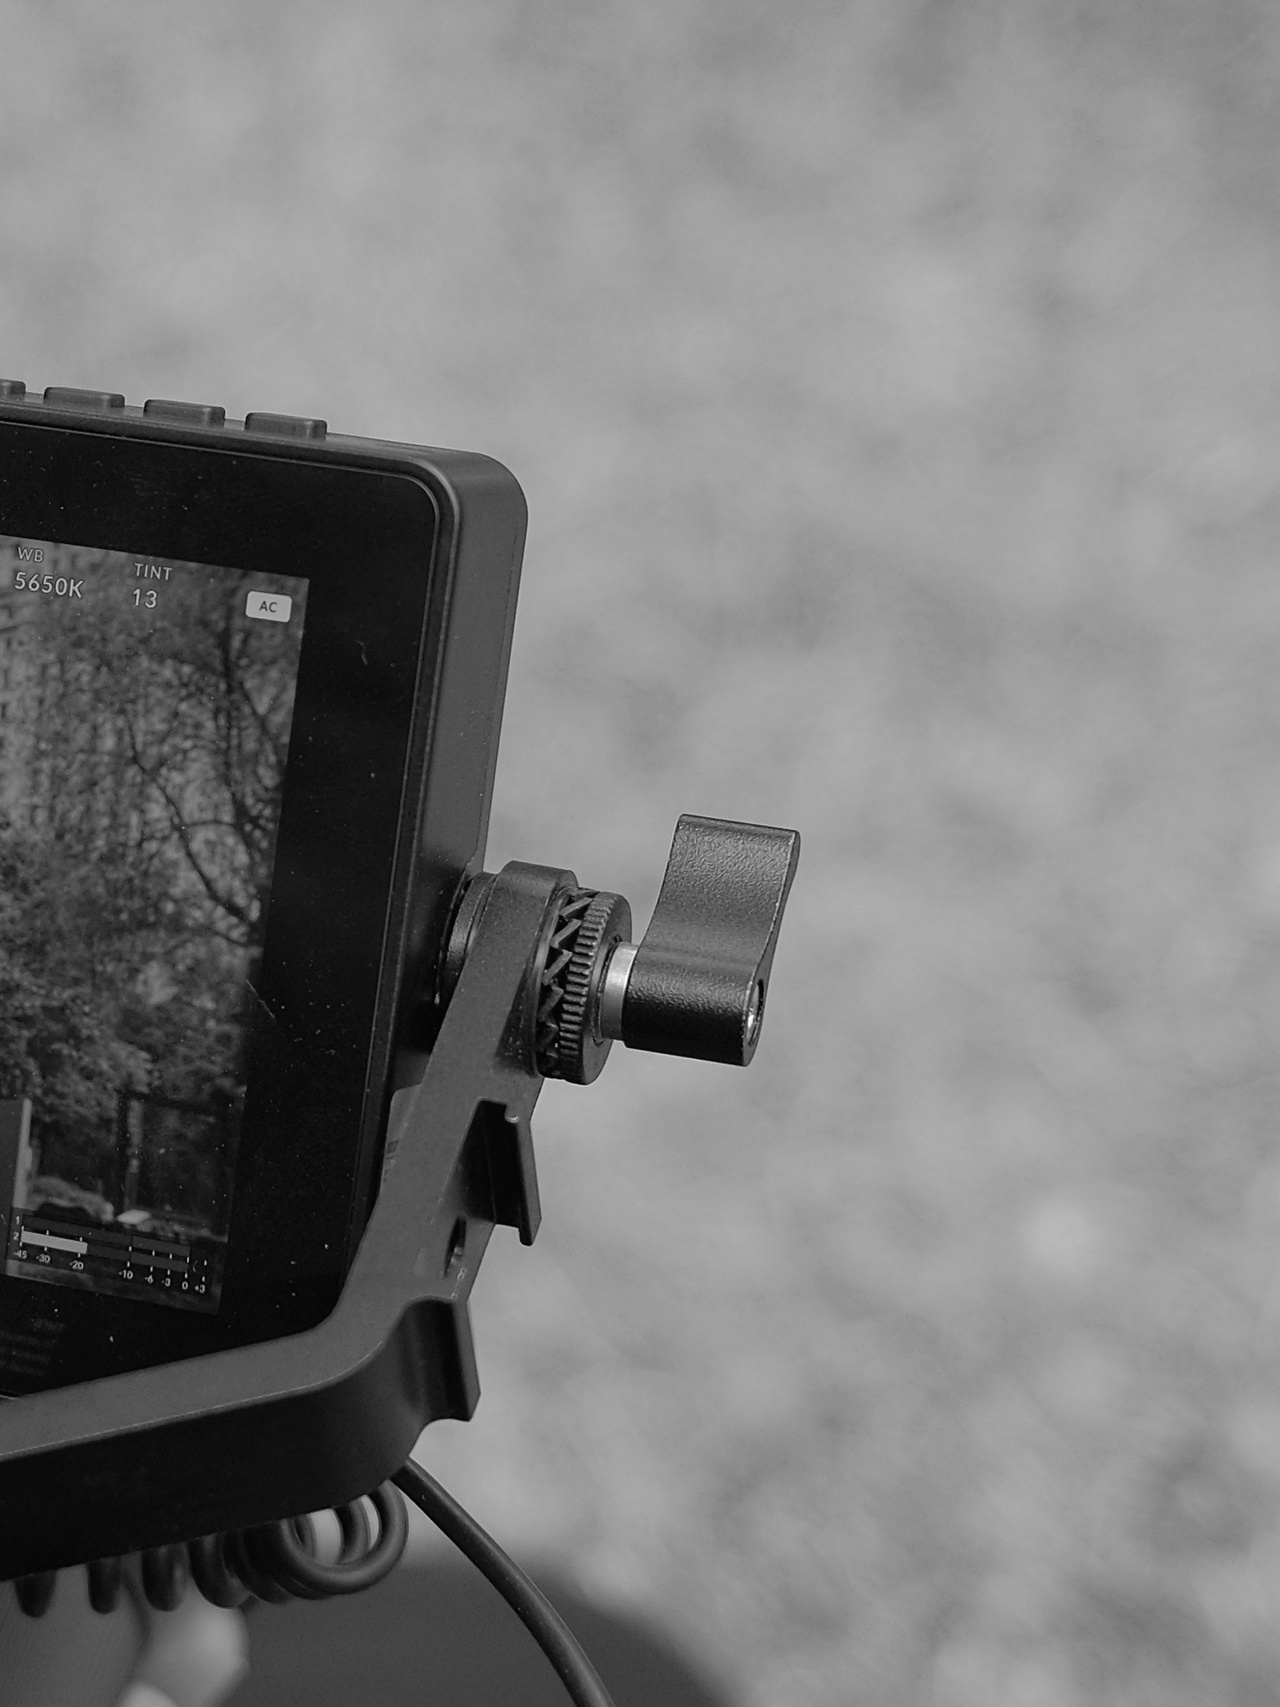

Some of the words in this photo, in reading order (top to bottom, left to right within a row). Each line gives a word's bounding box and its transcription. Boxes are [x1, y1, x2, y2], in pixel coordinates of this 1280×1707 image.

[17, 547, 44, 563] WB
[133, 562, 173, 581] TINT
[14, 571, 84, 599] 5650K
[132, 587, 158, 609] 13
[259, 598, 278, 614] AC
[181, 1281, 189, 1290] 0
